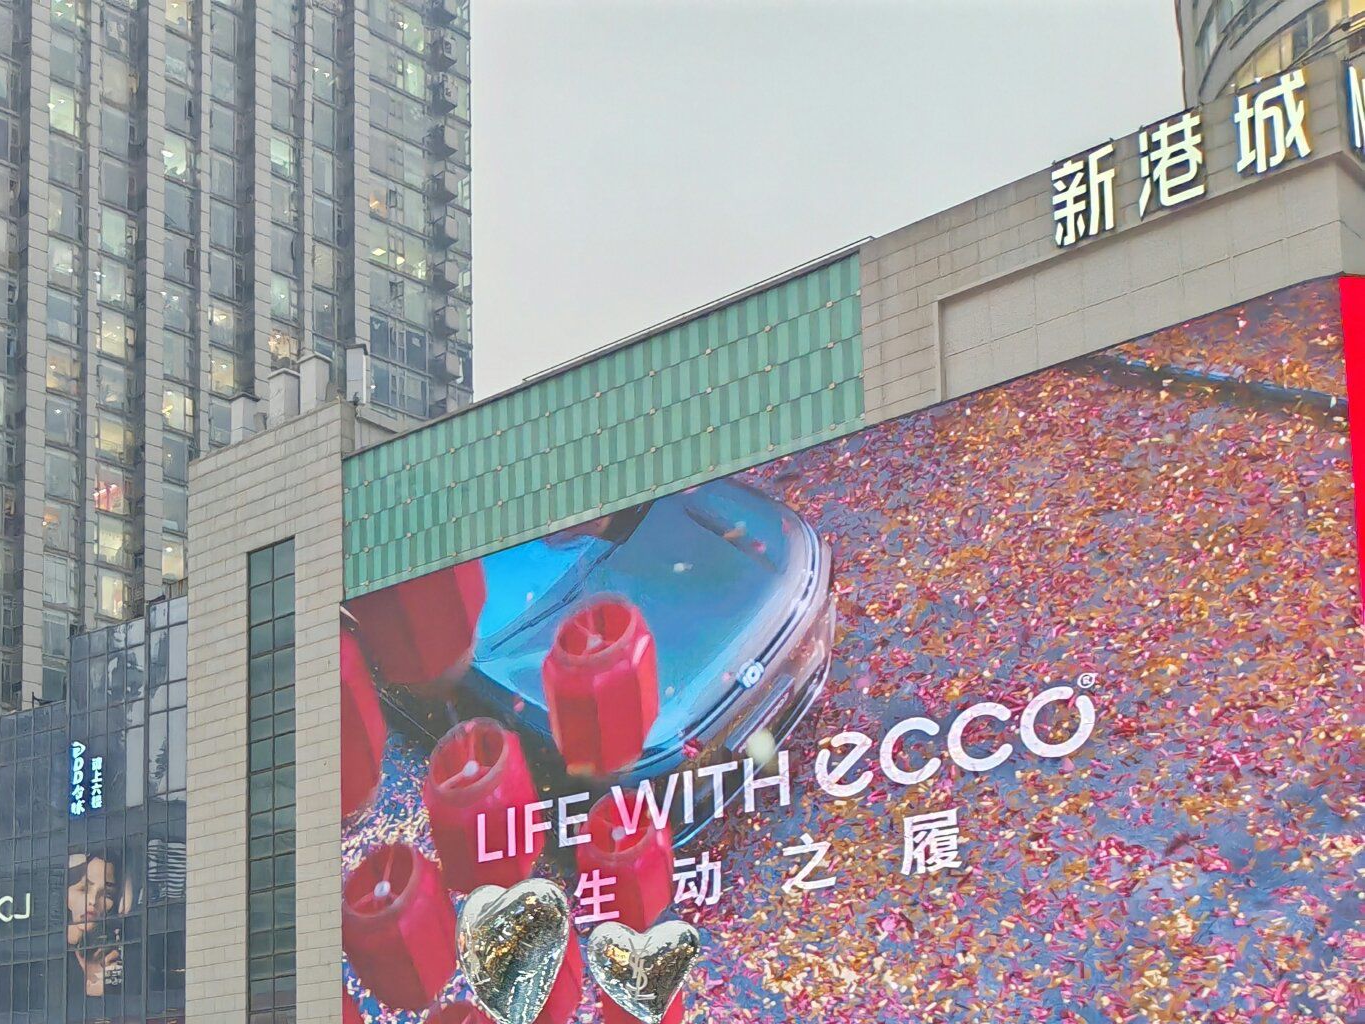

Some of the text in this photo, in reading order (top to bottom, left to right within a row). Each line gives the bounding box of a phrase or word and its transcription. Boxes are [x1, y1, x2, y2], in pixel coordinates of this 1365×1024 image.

[1051, 69, 1311, 247] 新港城
[477, 685, 1097, 864] LIFE WITH ecco
[573, 808, 963, 926] 生动之履
